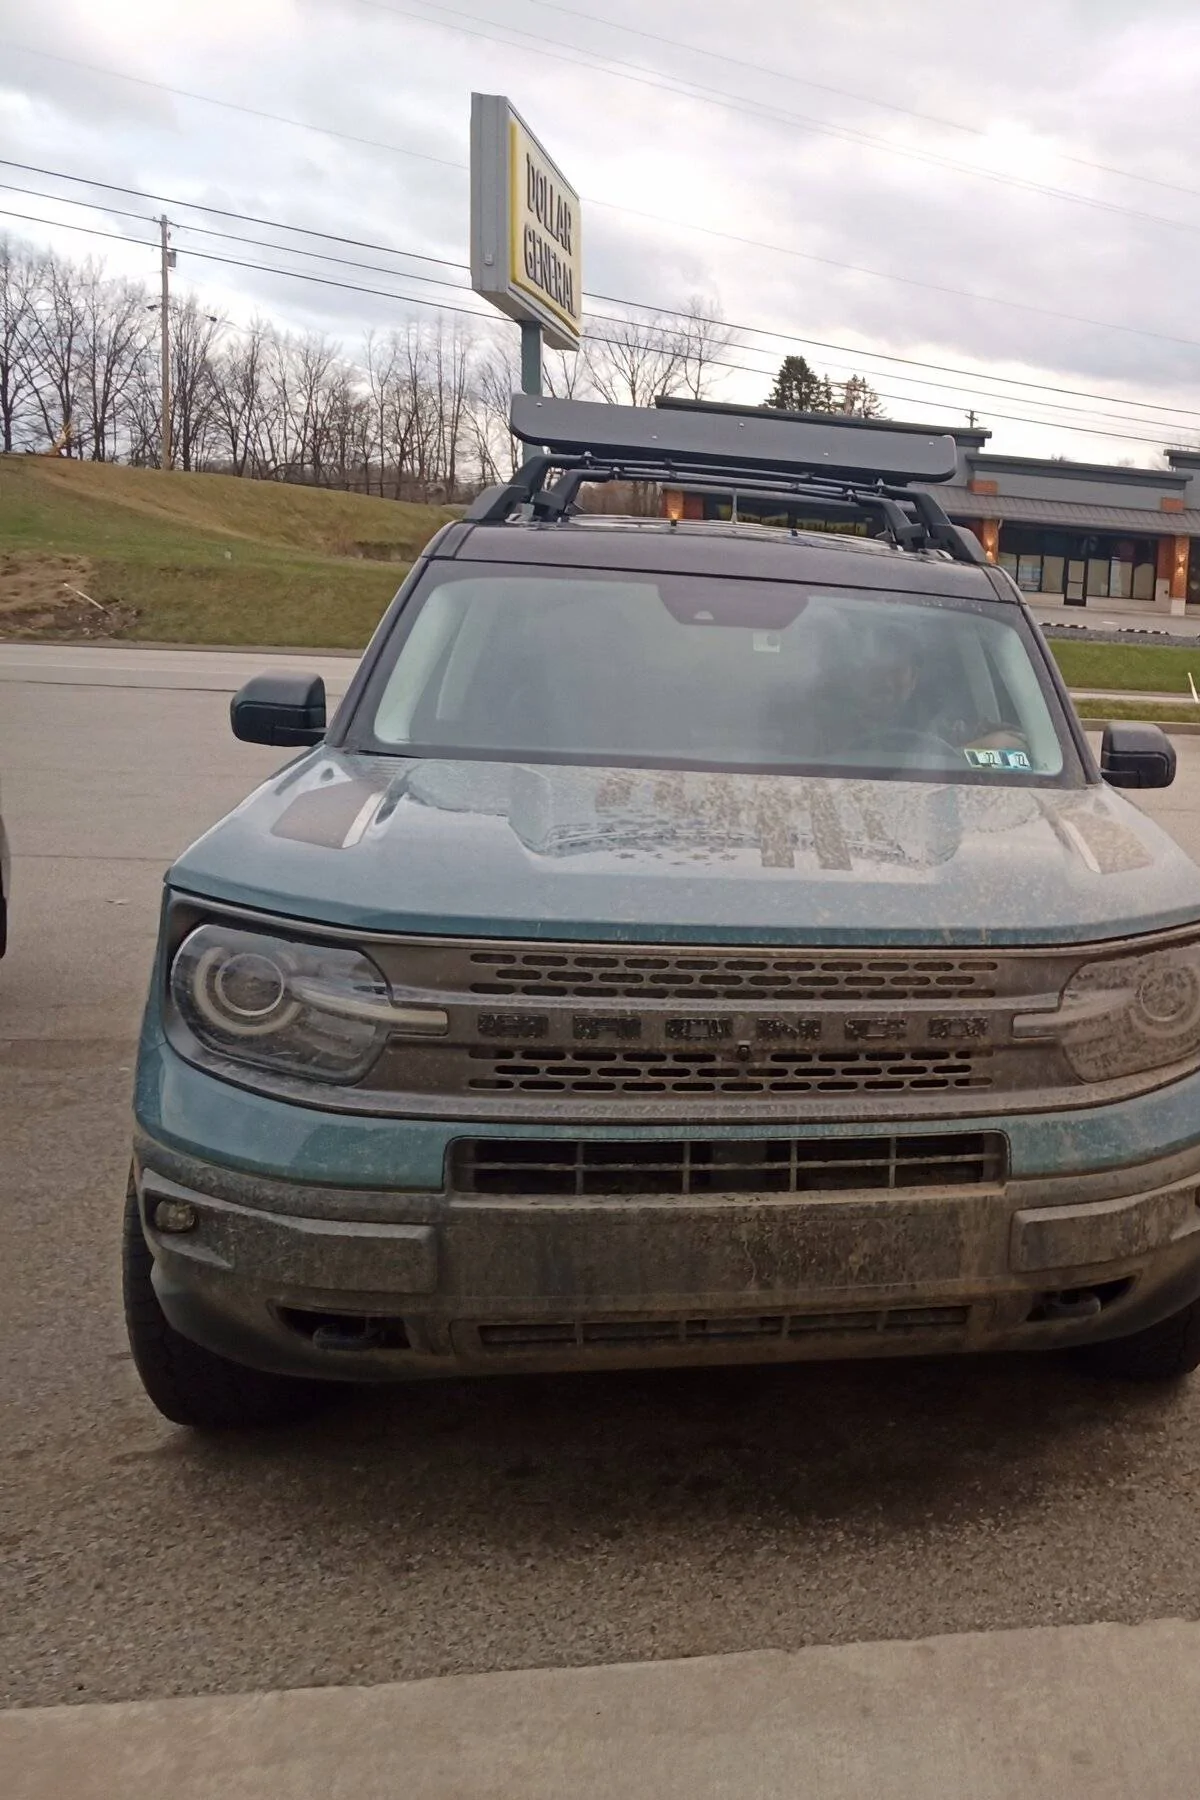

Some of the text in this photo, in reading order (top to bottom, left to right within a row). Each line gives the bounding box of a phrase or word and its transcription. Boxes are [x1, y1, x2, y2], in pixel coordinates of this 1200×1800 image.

[525, 152, 572, 256] DOLLAR
[523, 221, 577, 319] GENERAL
[478, 1012, 988, 1040] BRONCO
